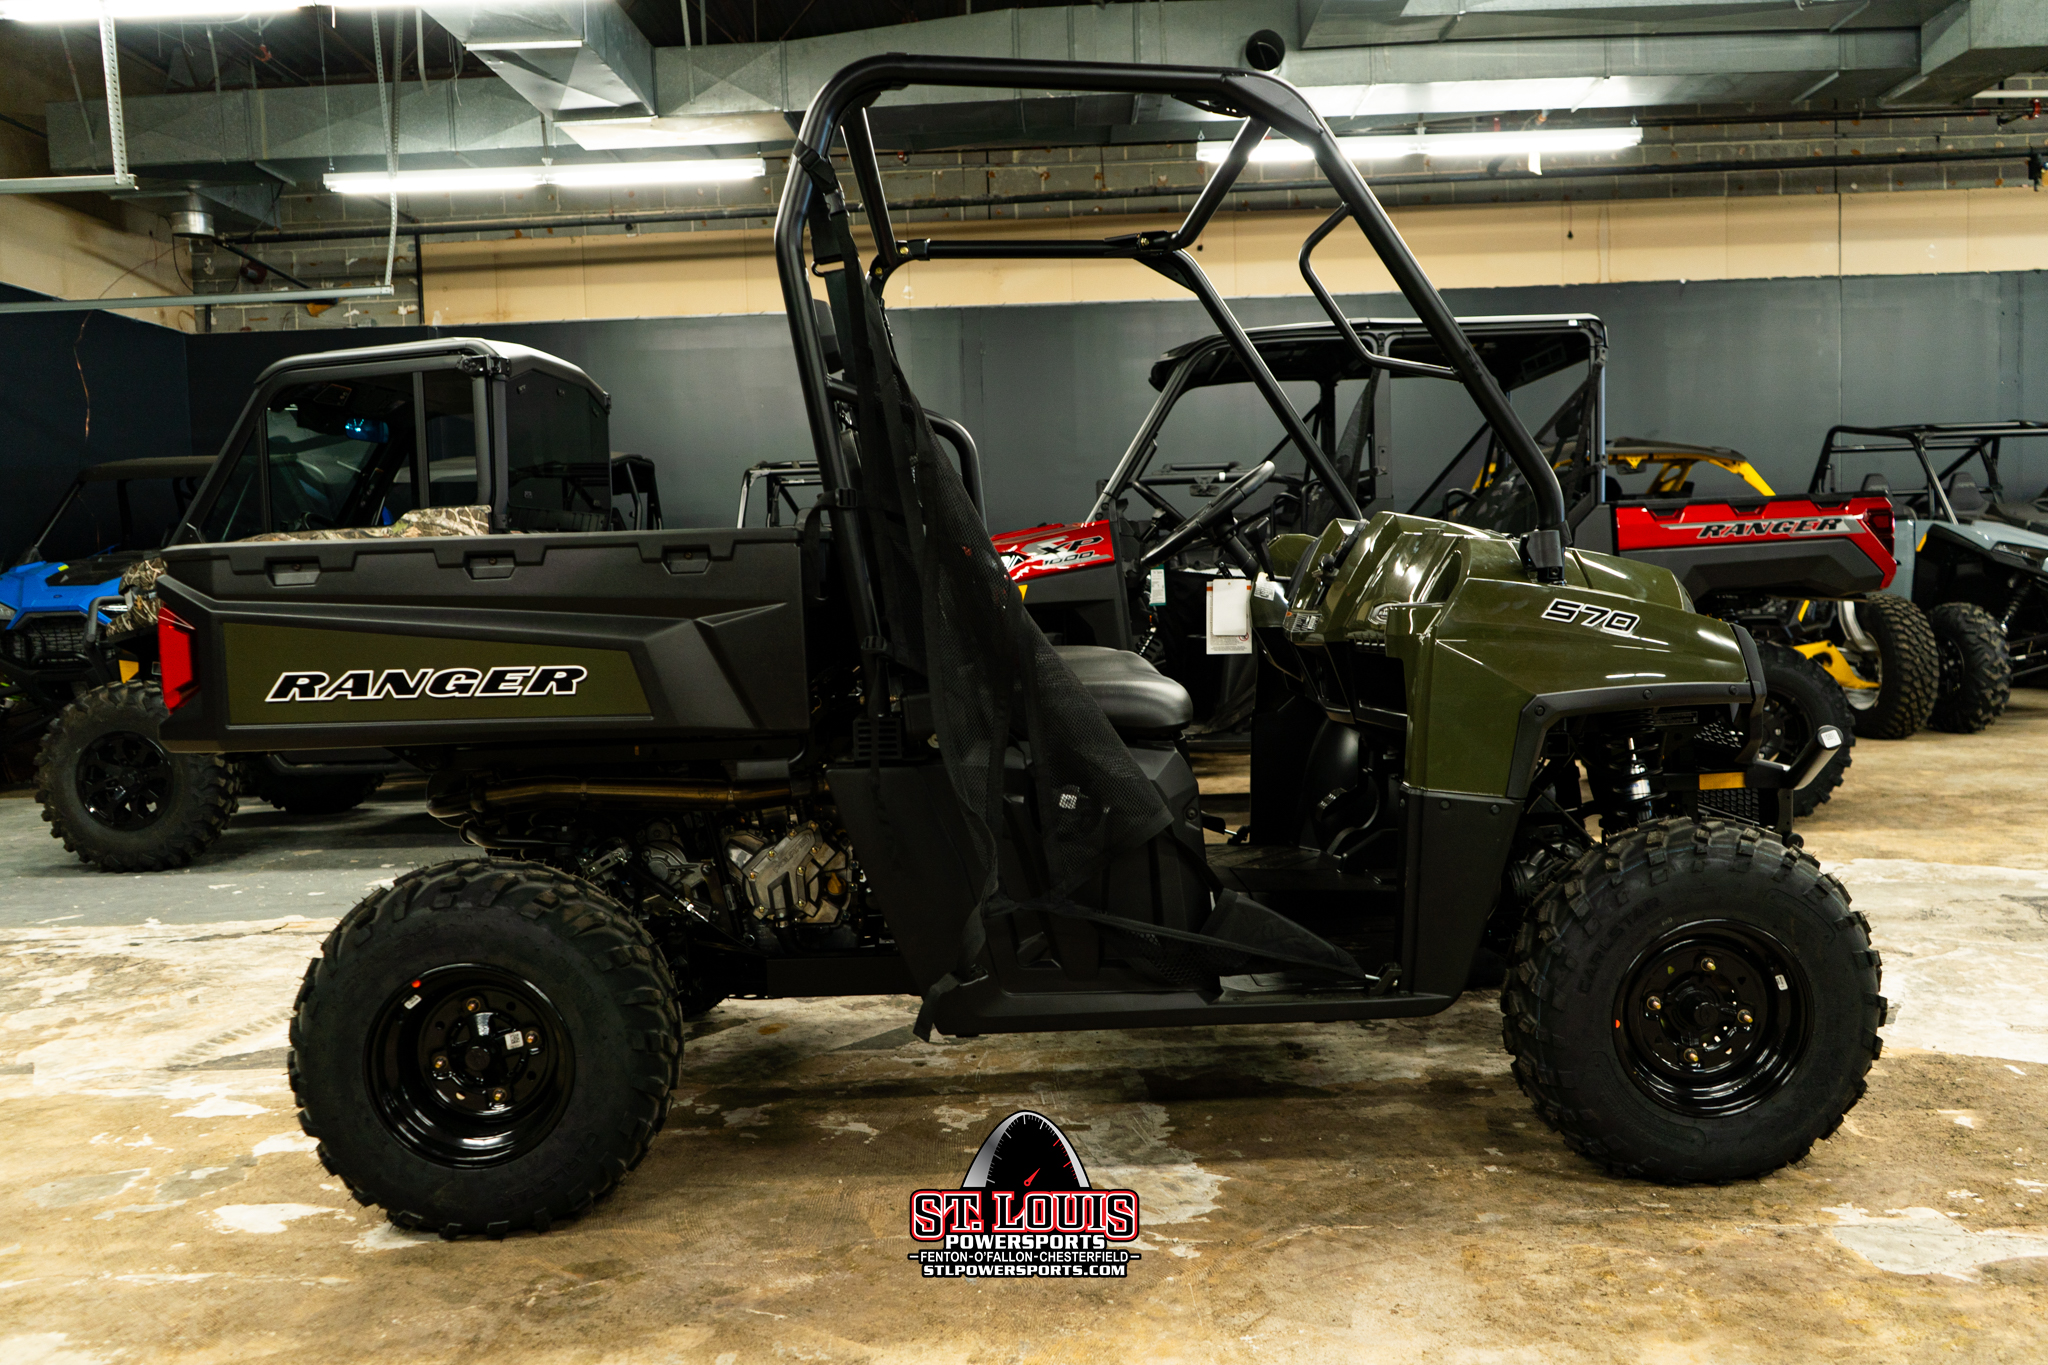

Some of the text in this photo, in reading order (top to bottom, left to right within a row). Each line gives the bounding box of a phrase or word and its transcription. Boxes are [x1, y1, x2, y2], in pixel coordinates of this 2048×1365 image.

[1697, 517, 1844, 539] RANGER
[1040, 535, 1104, 556] XP
[1043, 550, 1096, 566] 1000
[1541, 598, 1640, 634] 570
[265, 665, 588, 702] RANGER
